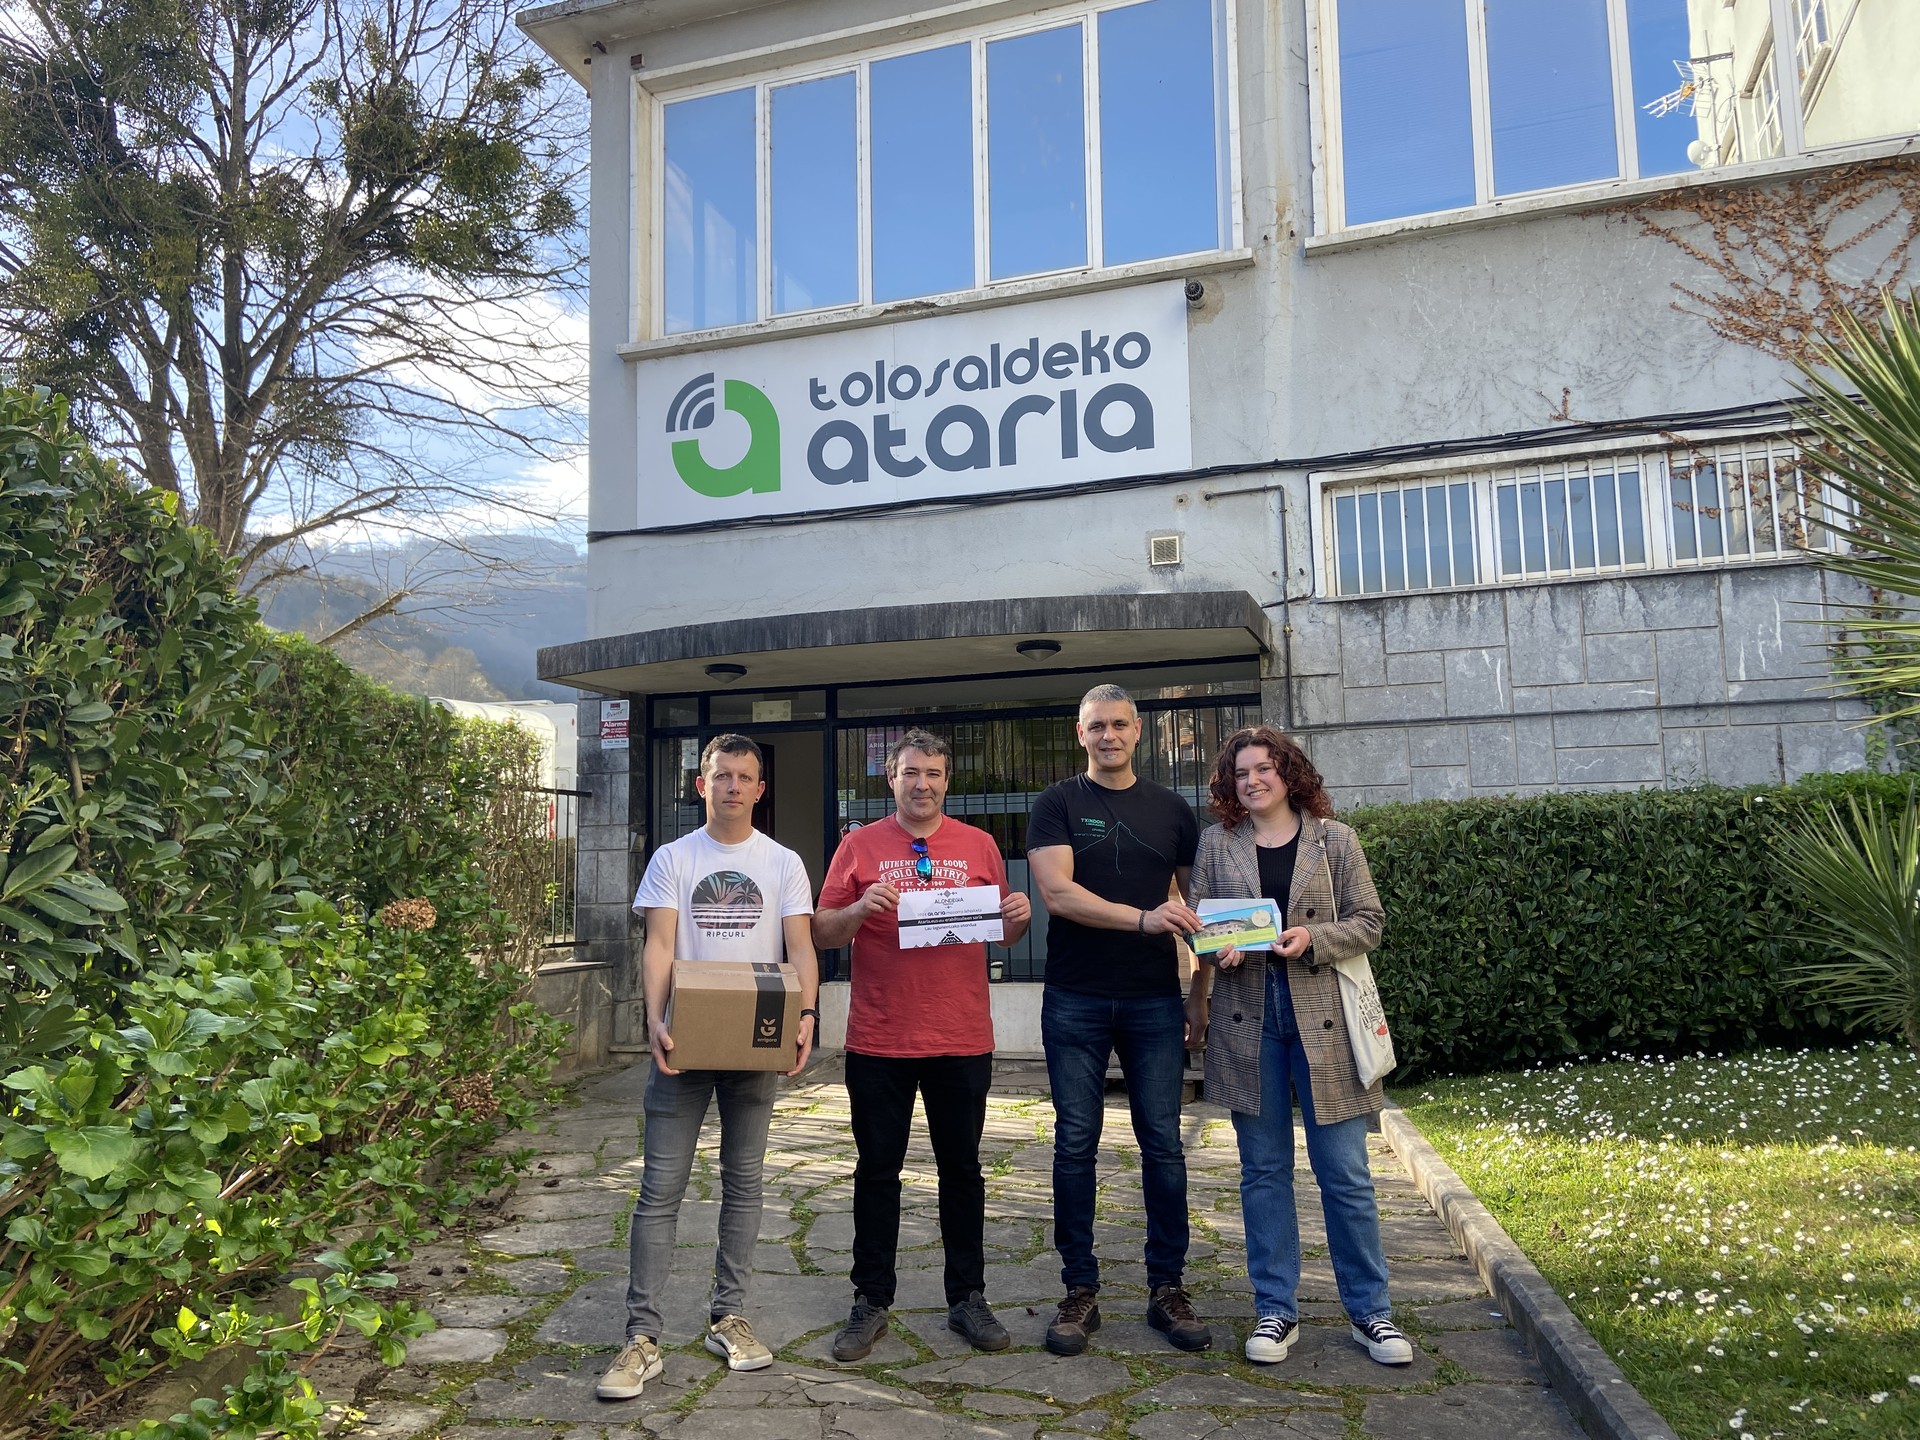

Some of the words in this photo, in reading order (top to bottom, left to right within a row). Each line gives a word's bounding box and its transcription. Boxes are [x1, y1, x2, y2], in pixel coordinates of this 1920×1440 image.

[809, 329, 1151, 411] tolosaldeko
[806, 382, 1155, 486] ataria
[878, 859, 917, 872] AUTHENTI
[943, 859, 968, 870] GOODS
[887, 868, 912, 881] POLO
